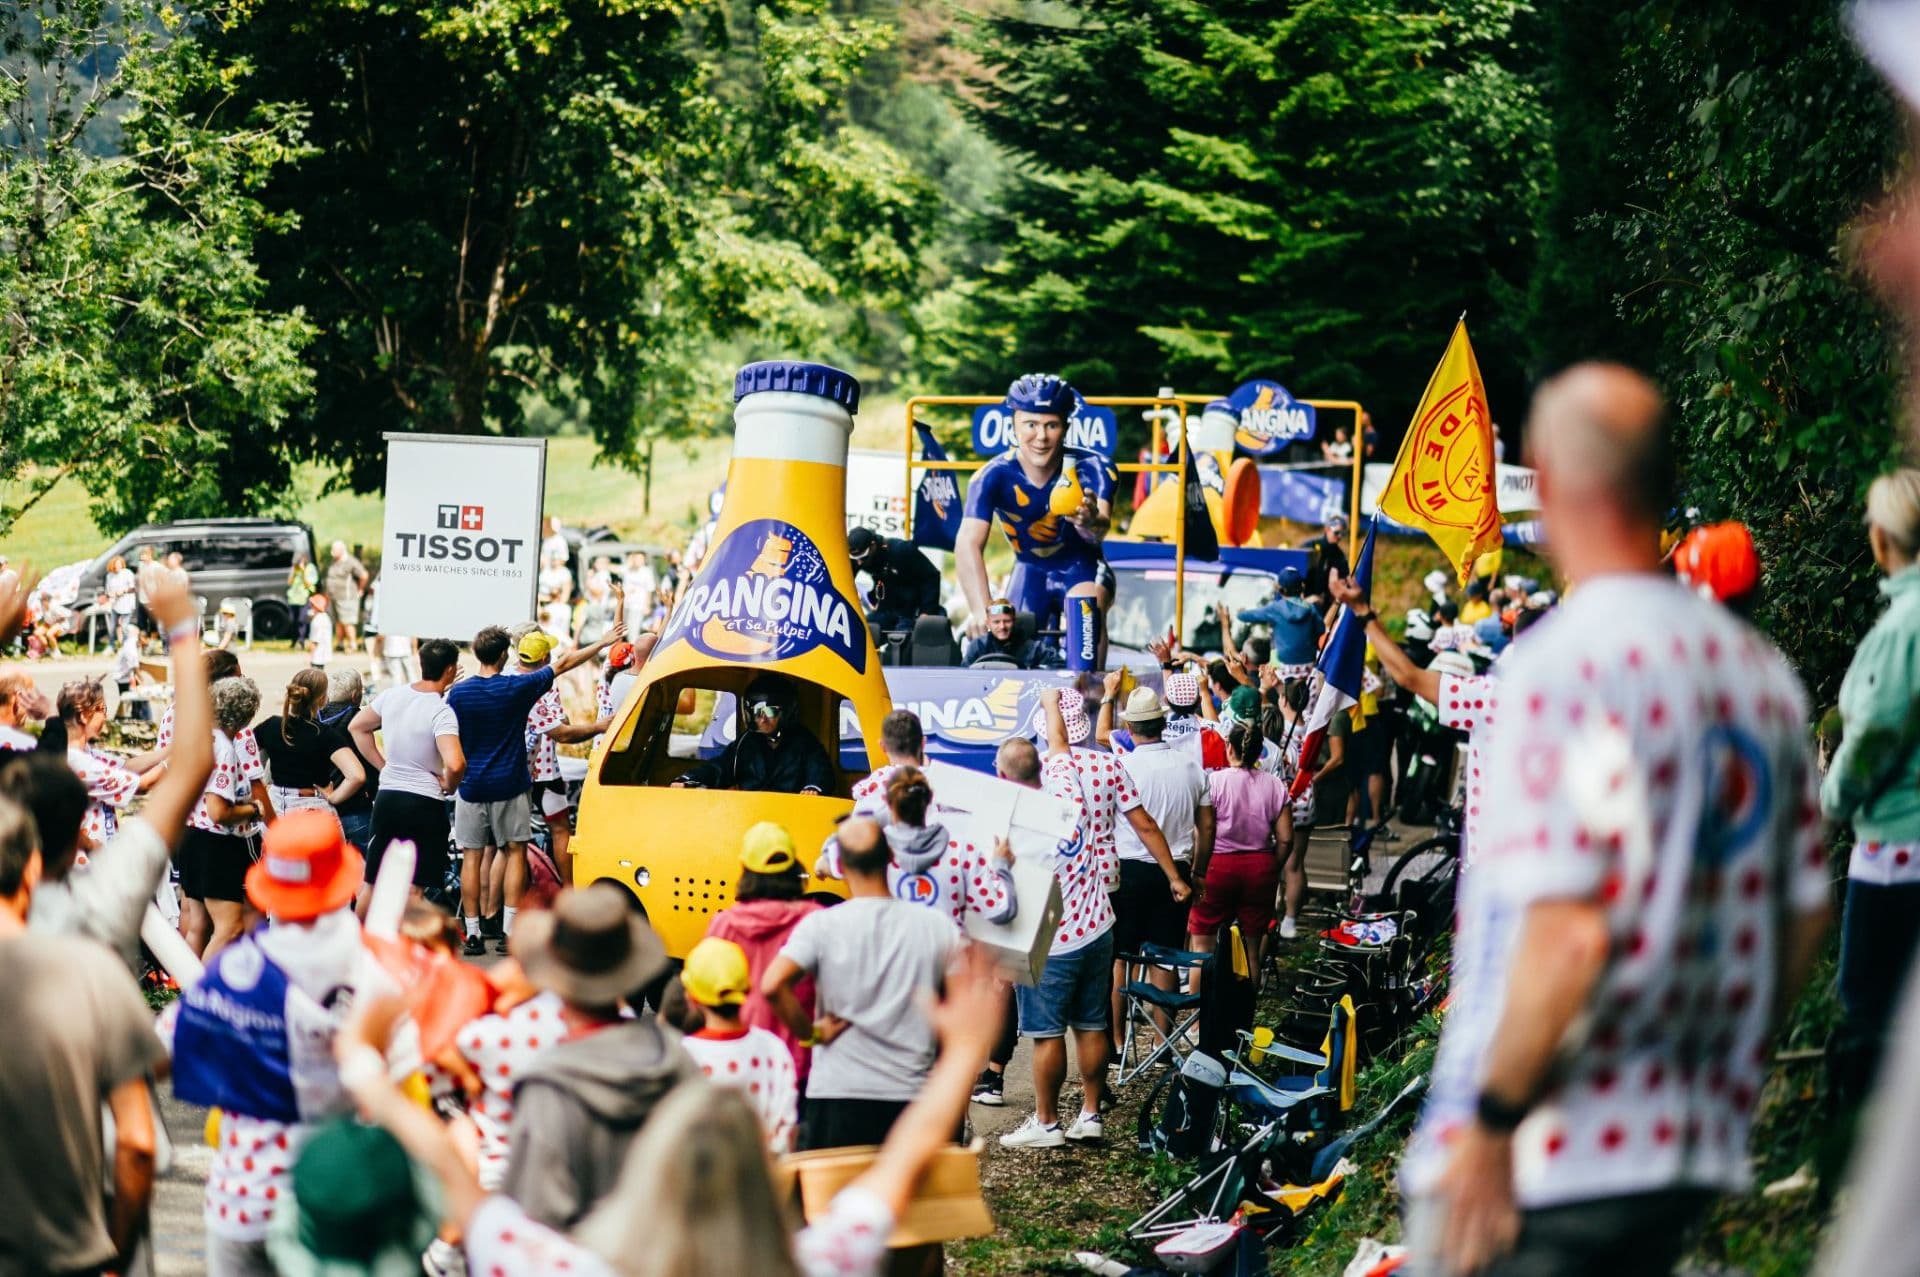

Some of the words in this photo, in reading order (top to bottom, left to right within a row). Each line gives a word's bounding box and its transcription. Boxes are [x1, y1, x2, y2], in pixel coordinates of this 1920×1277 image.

[979, 409, 1107, 448] ORINA
[1241, 408, 1309, 434] ANGINA
[848, 514, 906, 532] TISS
[396, 532, 523, 564] TISSOT
[393, 563, 421, 572] SWISS
[424, 565, 467, 574] WATCHES
[471, 568, 498, 576] SINCE
